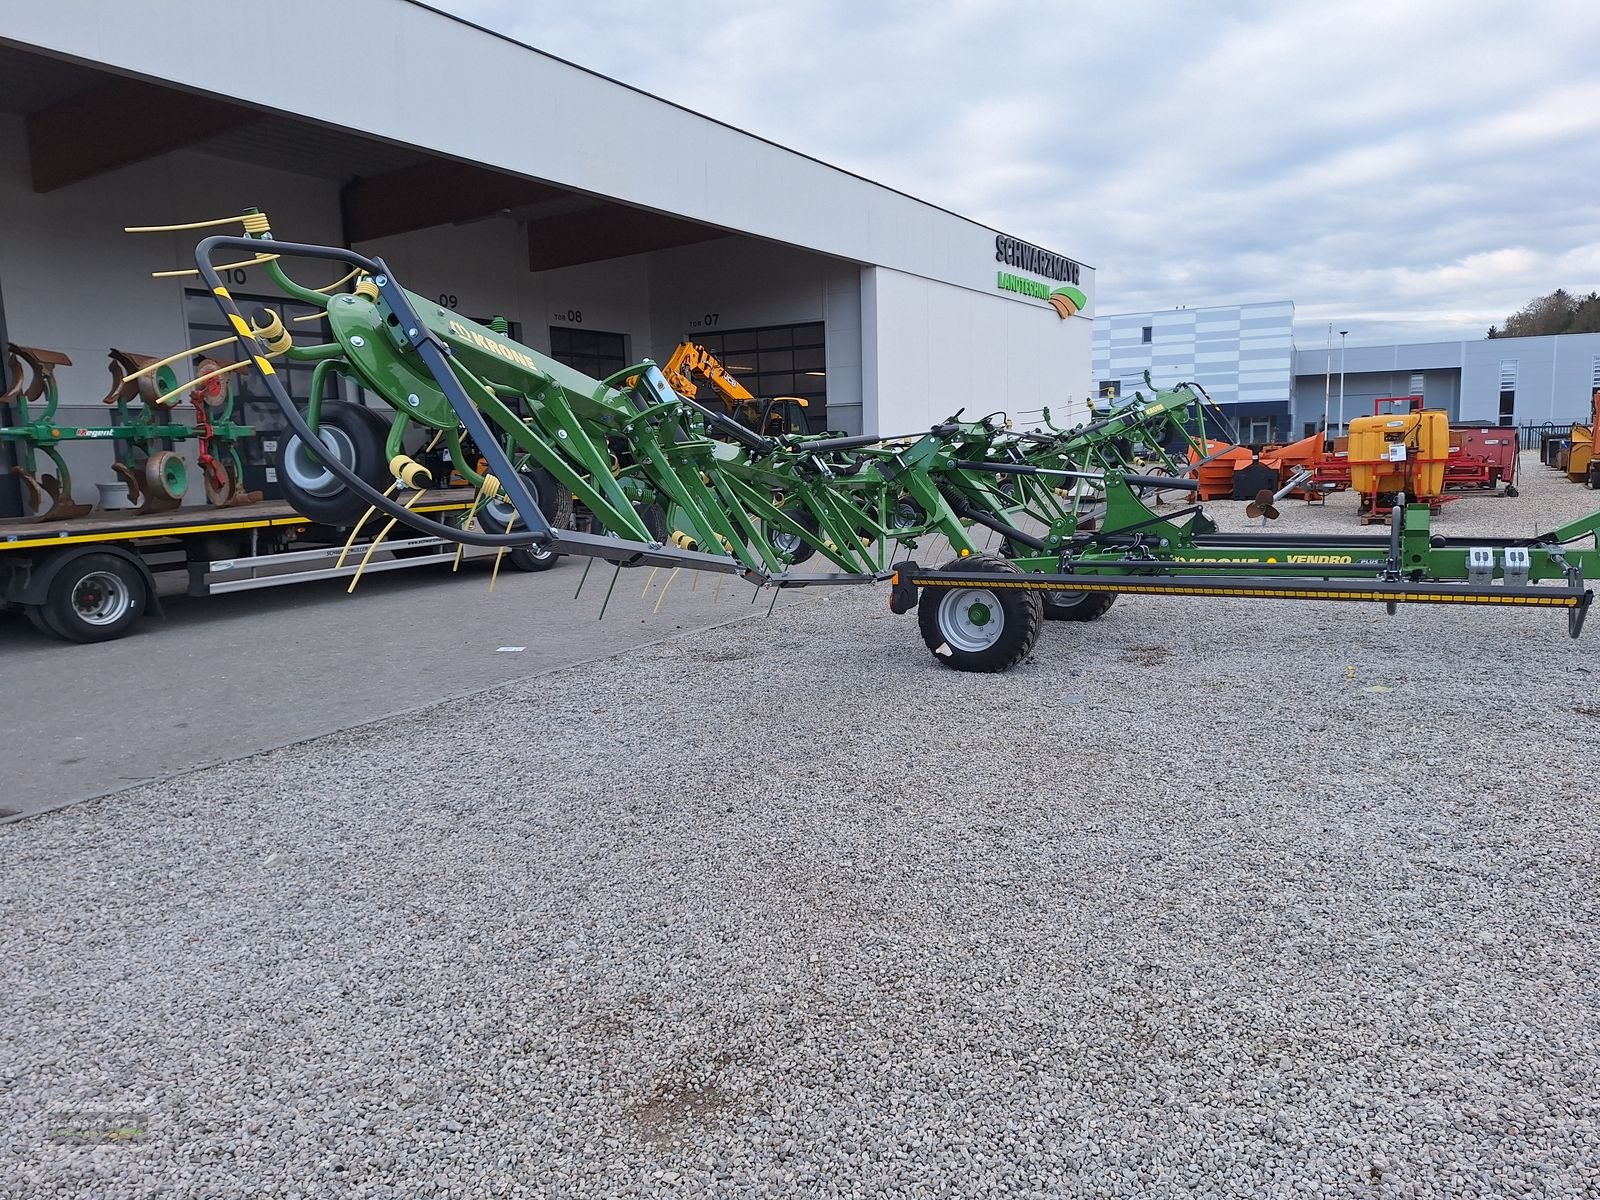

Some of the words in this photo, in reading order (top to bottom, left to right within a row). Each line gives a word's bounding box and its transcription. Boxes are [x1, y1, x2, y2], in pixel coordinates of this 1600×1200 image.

[996, 235, 1080, 285] SCHWARZMAYR
[225, 268, 246, 285] 10
[998, 271, 1049, 301] LANDTECHNIK
[440, 294, 457, 308] 09
[568, 310, 583, 323] 08
[704, 313, 719, 326] 07
[470, 330, 538, 371] KRONE
[1286, 555, 1352, 564] VENDRO
